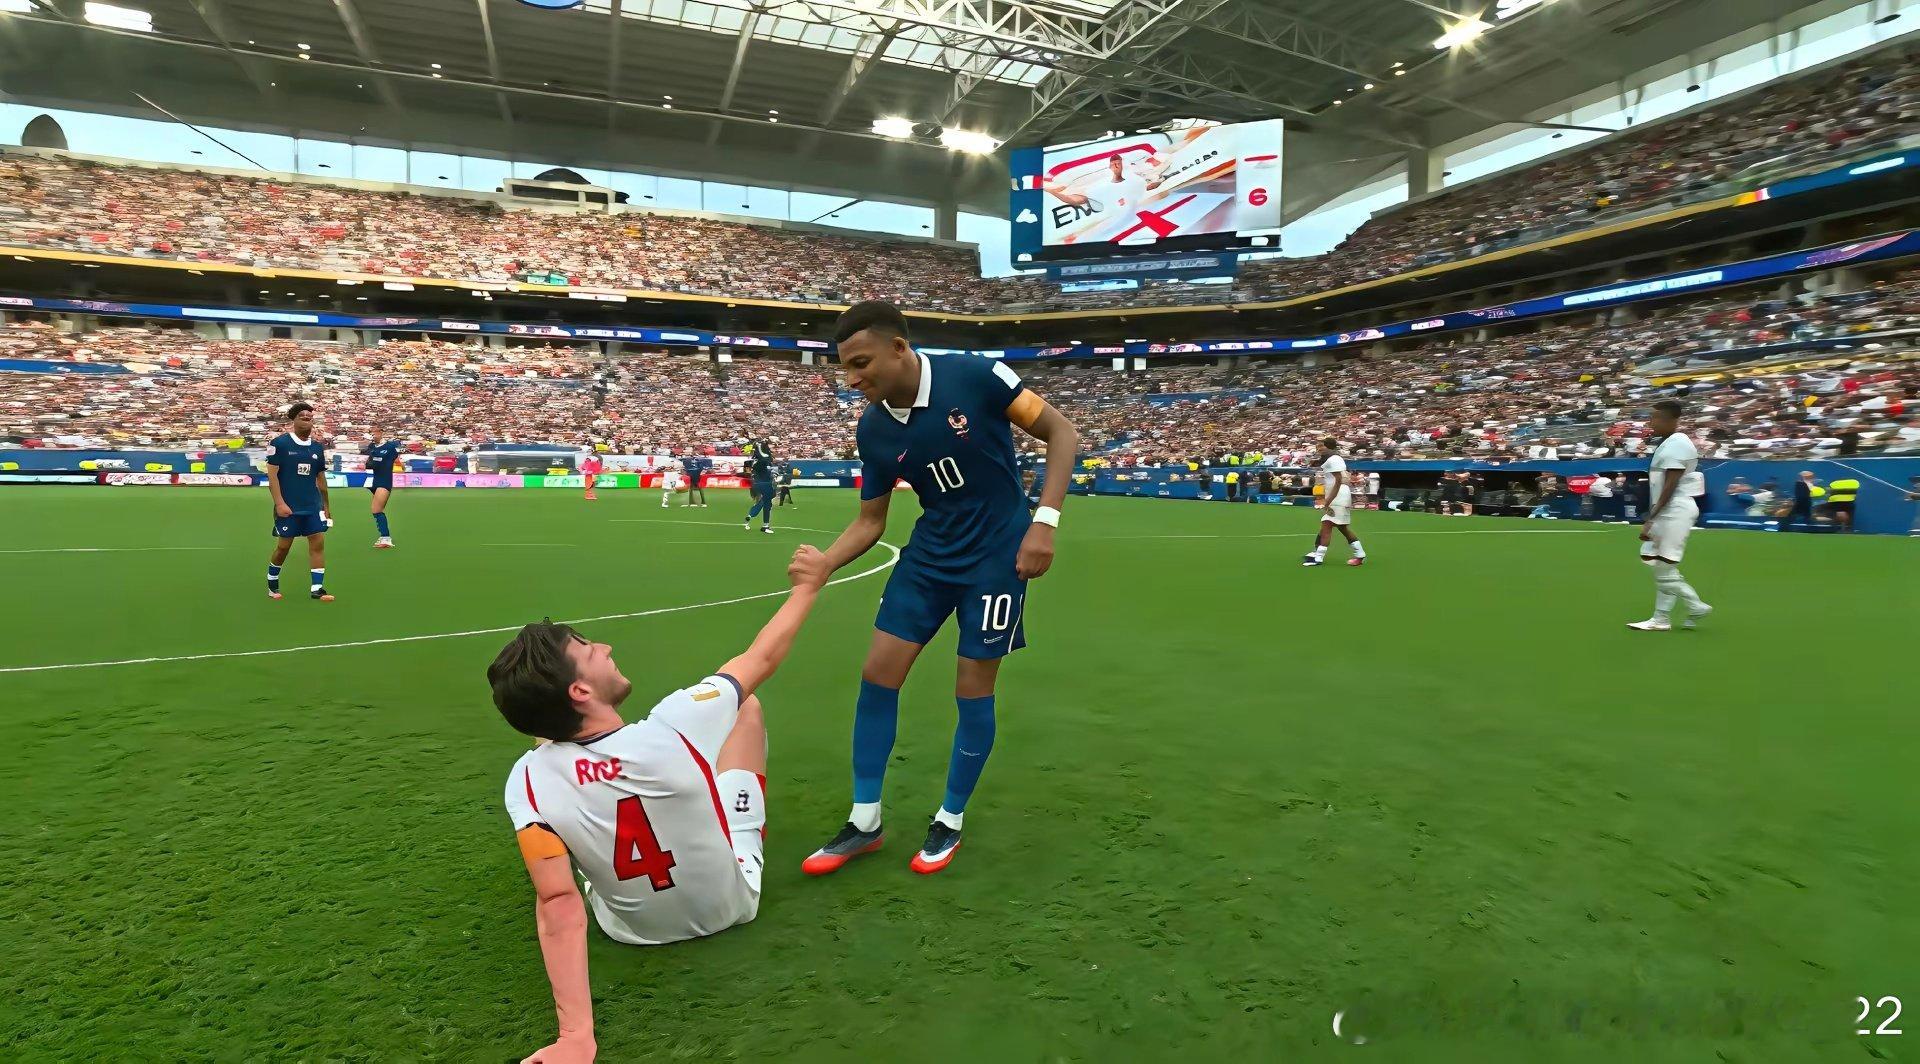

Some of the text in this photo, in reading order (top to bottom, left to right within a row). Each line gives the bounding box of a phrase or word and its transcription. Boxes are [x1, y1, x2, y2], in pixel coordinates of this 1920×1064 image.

[1249, 188, 1267, 206] 6
[927, 456, 964, 492] 10
[982, 594, 1011, 630] 10
[613, 794, 676, 892] 4
